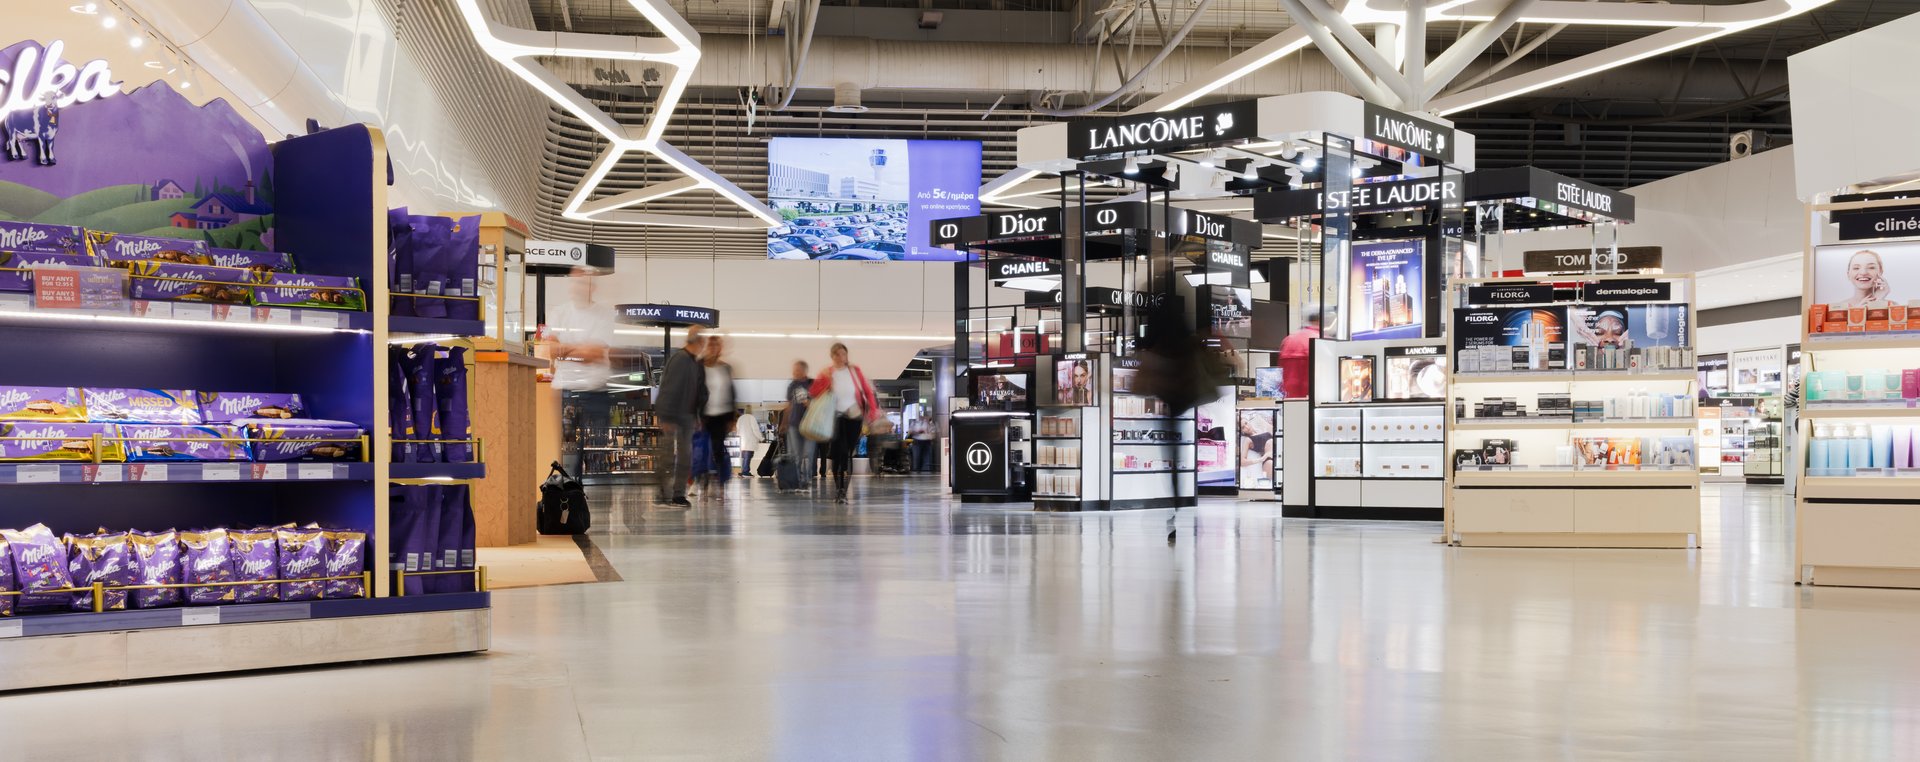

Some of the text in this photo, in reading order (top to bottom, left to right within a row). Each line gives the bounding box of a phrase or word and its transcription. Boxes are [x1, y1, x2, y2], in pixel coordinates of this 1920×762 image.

[1089, 116, 1204, 150] LANCÔME
[1375, 115, 1433, 151] LANCÔME
[1377, 182, 1456, 205] LAUDER
[1557, 183, 1612, 213] ESTÉE LAUDER
[1000, 213, 1047, 235] Dior
[1195, 214, 1225, 238] Dior
[1875, 217, 1920, 232] cliné
[115, 240, 162, 257] Milka
[548, 248, 567, 257] GIN
[213, 254, 252, 269] Milka
[1001, 261, 1050, 275] CHANEL
[1211, 252, 1244, 267] CHANEL
[1555, 255, 1585, 266] TOM
[154, 270, 206, 293] Milka
[274, 278, 318, 298] Milka
[626, 308, 662, 317] METAXA
[676, 309, 711, 320] METAXA
[0, 388, 31, 408] ilka
[128, 396, 173, 408] MISSED
[219, 395, 263, 415] Milka
[14, 427, 68, 450] Milka
[134, 427, 172, 443] Milka
[276, 434, 321, 454] Milka
[187, 441, 209, 453] You
[144, 560, 176, 581] Milka
[194, 555, 227, 571] Milka
[241, 558, 273, 574] Milka
[287, 555, 320, 574] Milka
